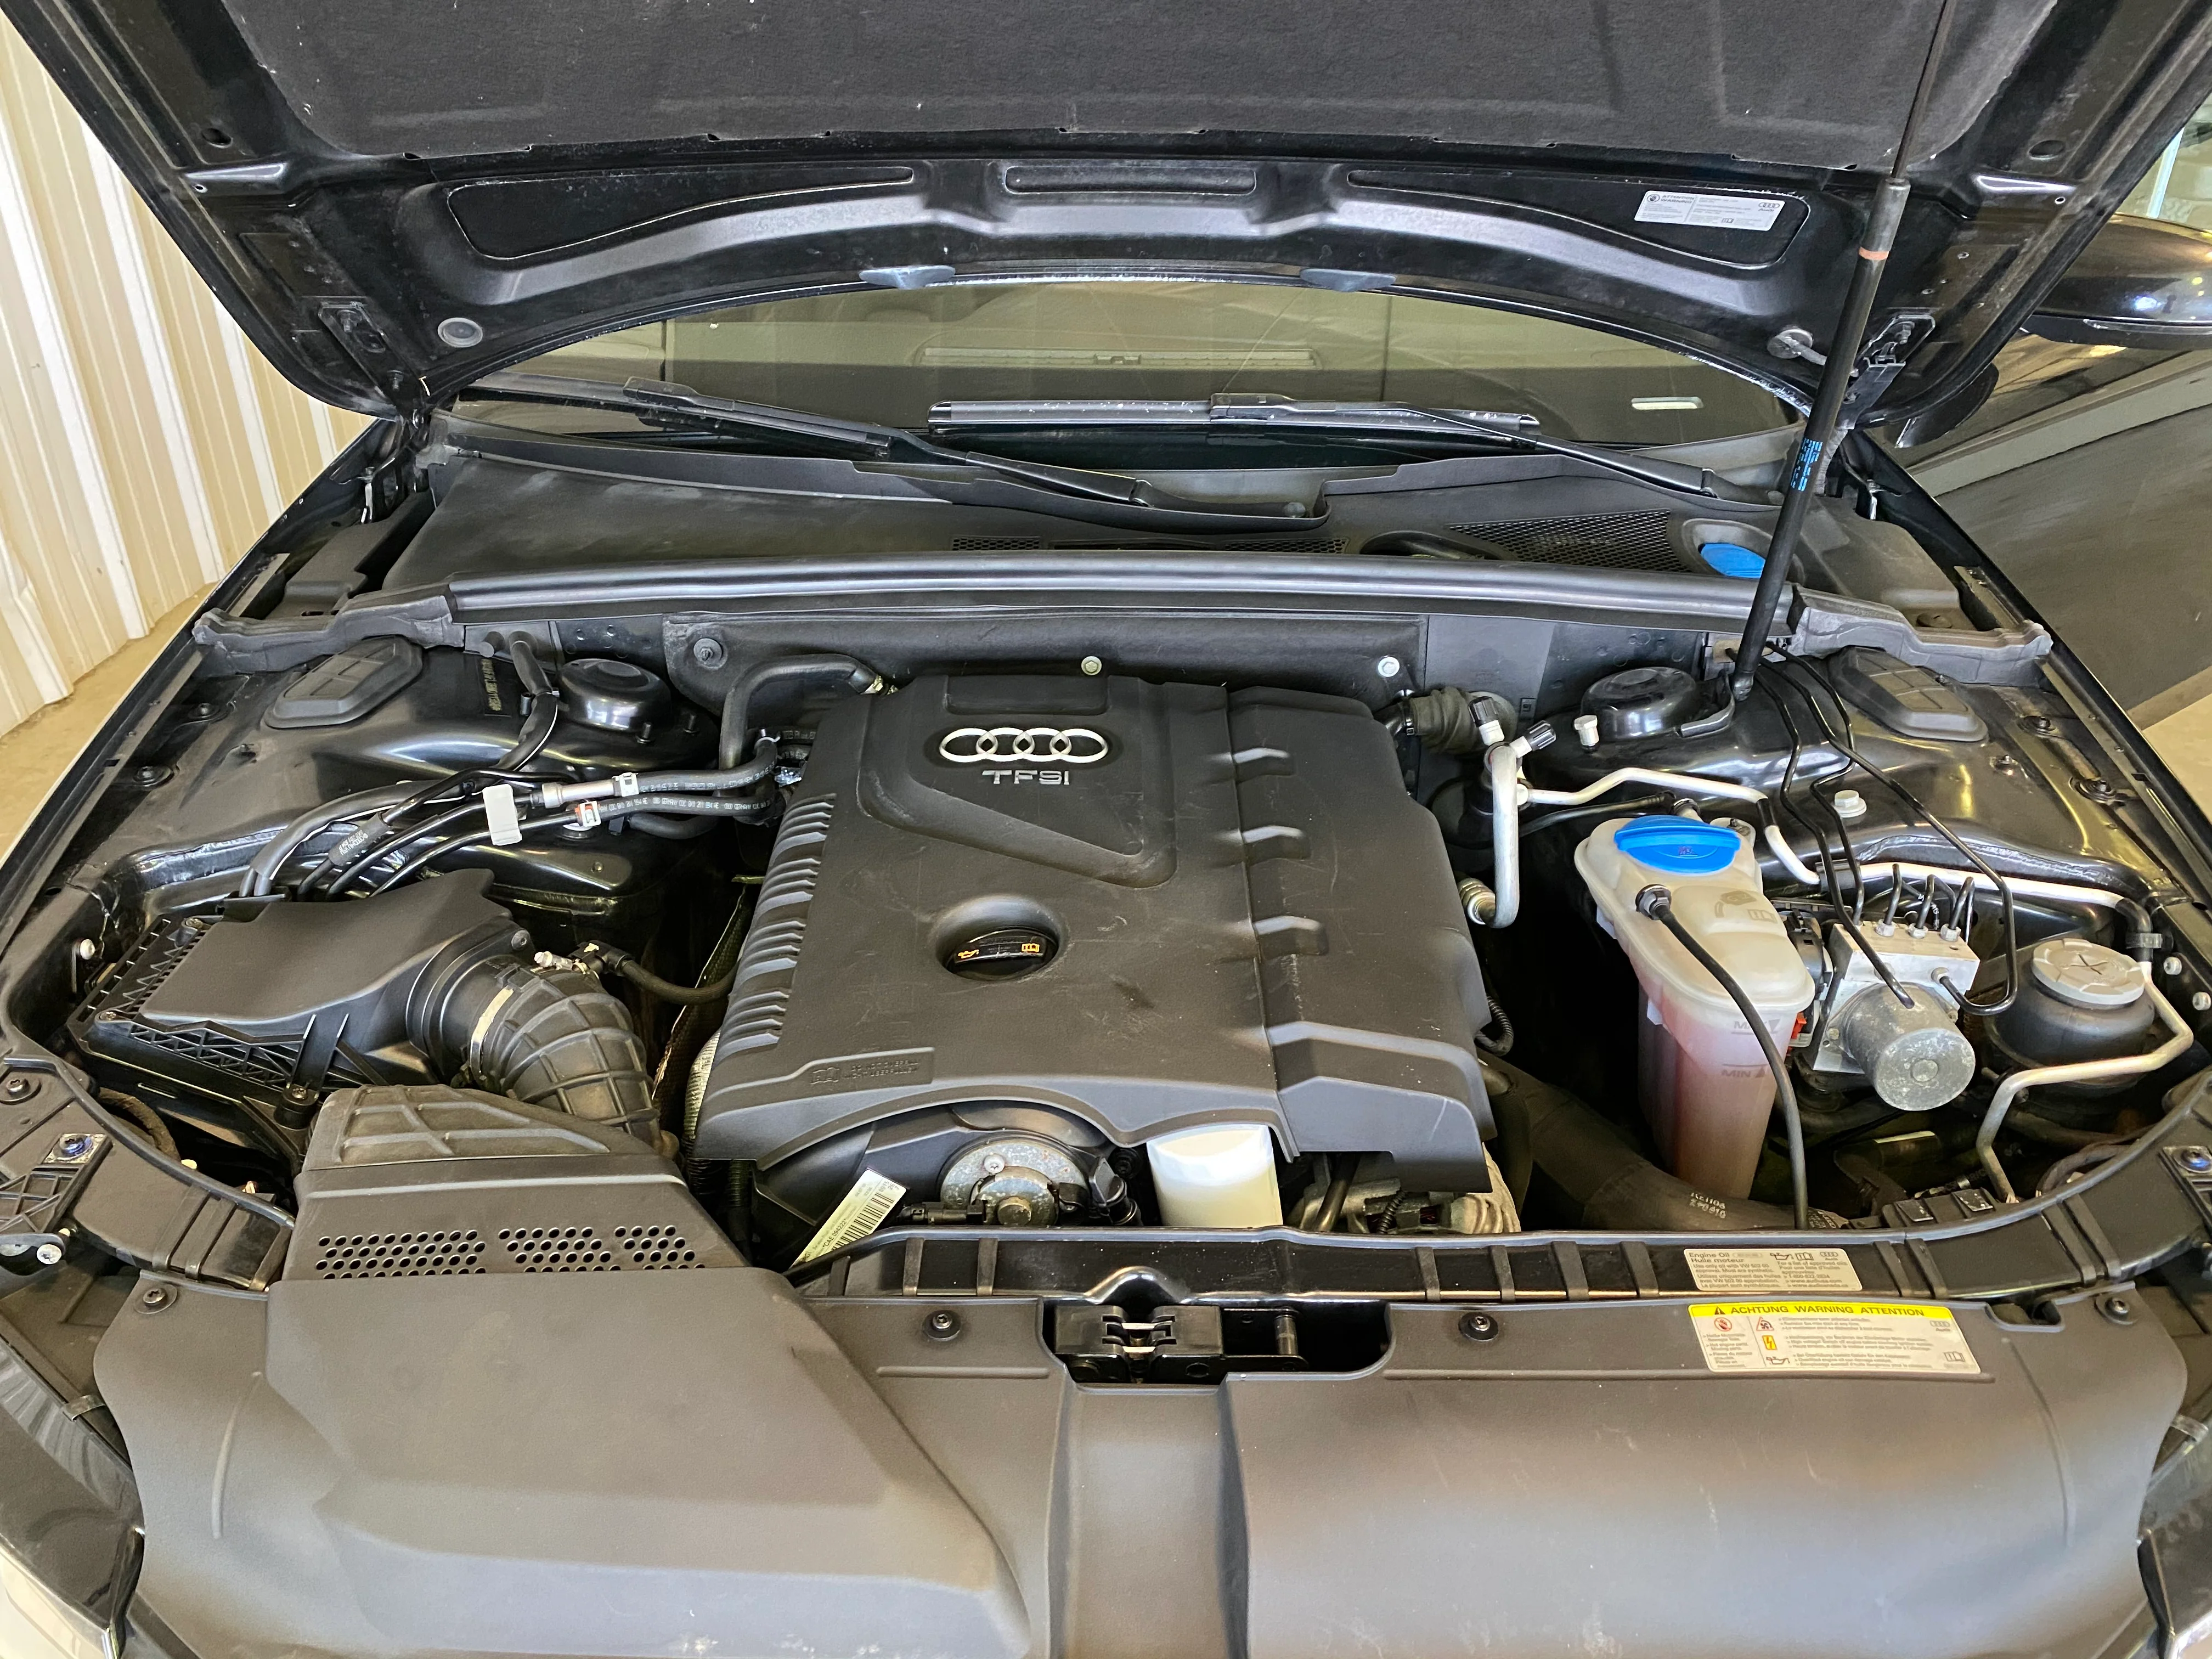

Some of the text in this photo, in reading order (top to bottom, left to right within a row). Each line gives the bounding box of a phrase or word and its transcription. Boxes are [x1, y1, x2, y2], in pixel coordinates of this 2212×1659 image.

[982, 770, 1070, 786] TFSI
[1721, 1069, 1751, 1077] MIN
[1731, 1306, 1788, 1314] ACHTUNG
[1861, 1307, 1924, 1316] ATTENTION
